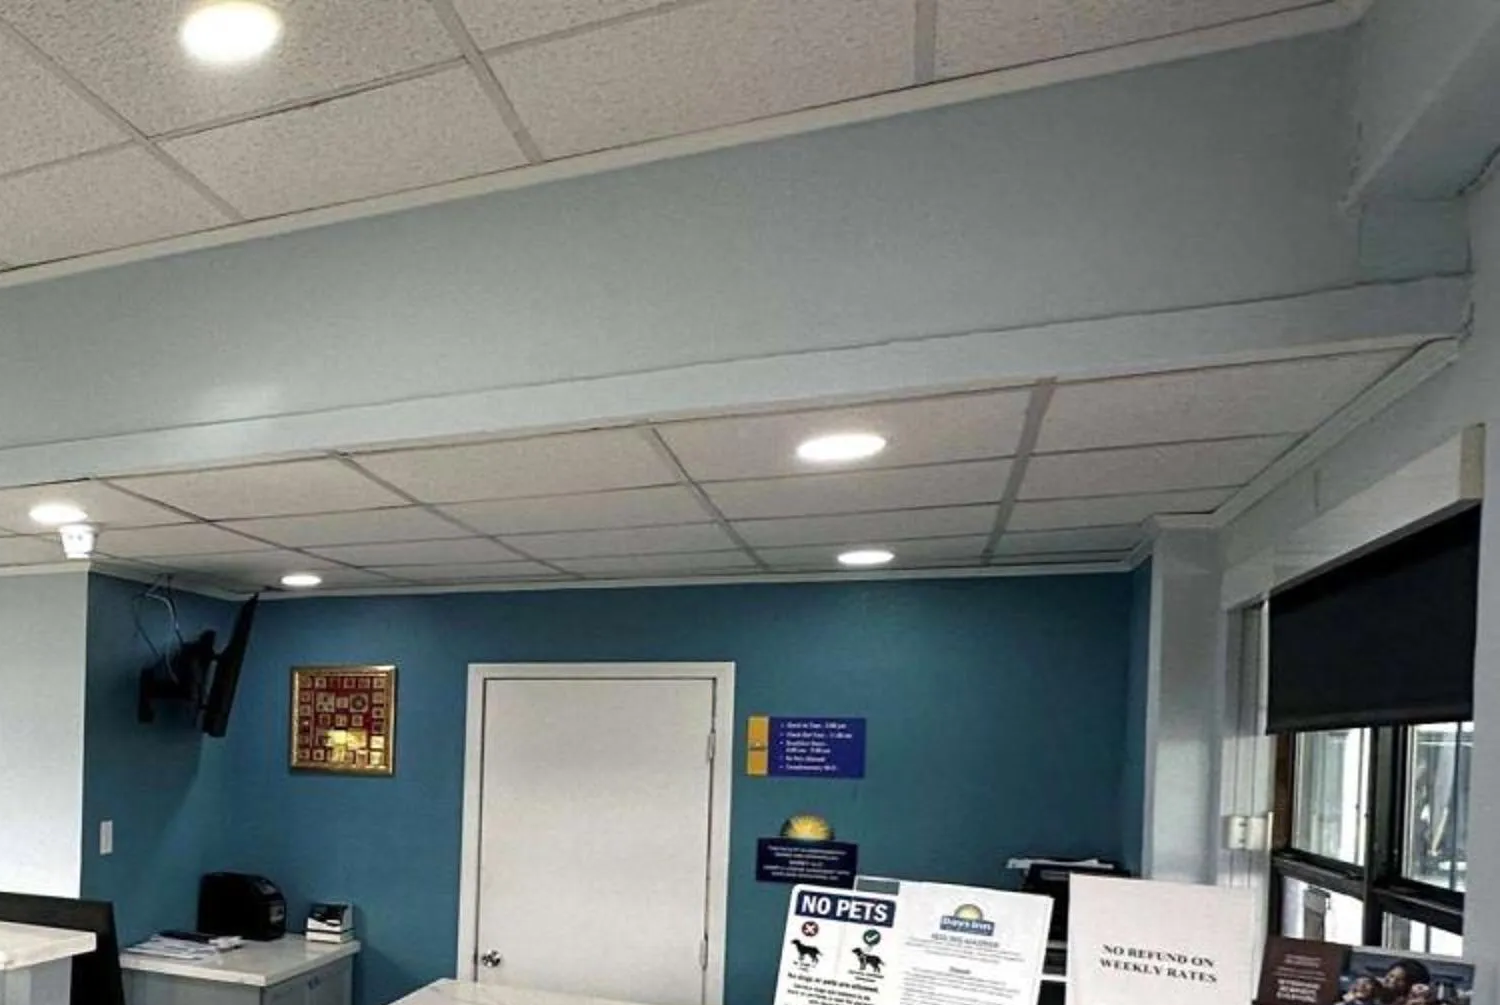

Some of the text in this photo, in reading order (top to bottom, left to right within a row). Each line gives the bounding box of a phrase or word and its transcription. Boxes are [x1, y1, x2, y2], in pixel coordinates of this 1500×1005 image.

[801, 895, 888, 923] NO PETS
[1102, 943, 1214, 968] NO REFUND ON
[1099, 958, 1218, 983] WEEKLY RATES
